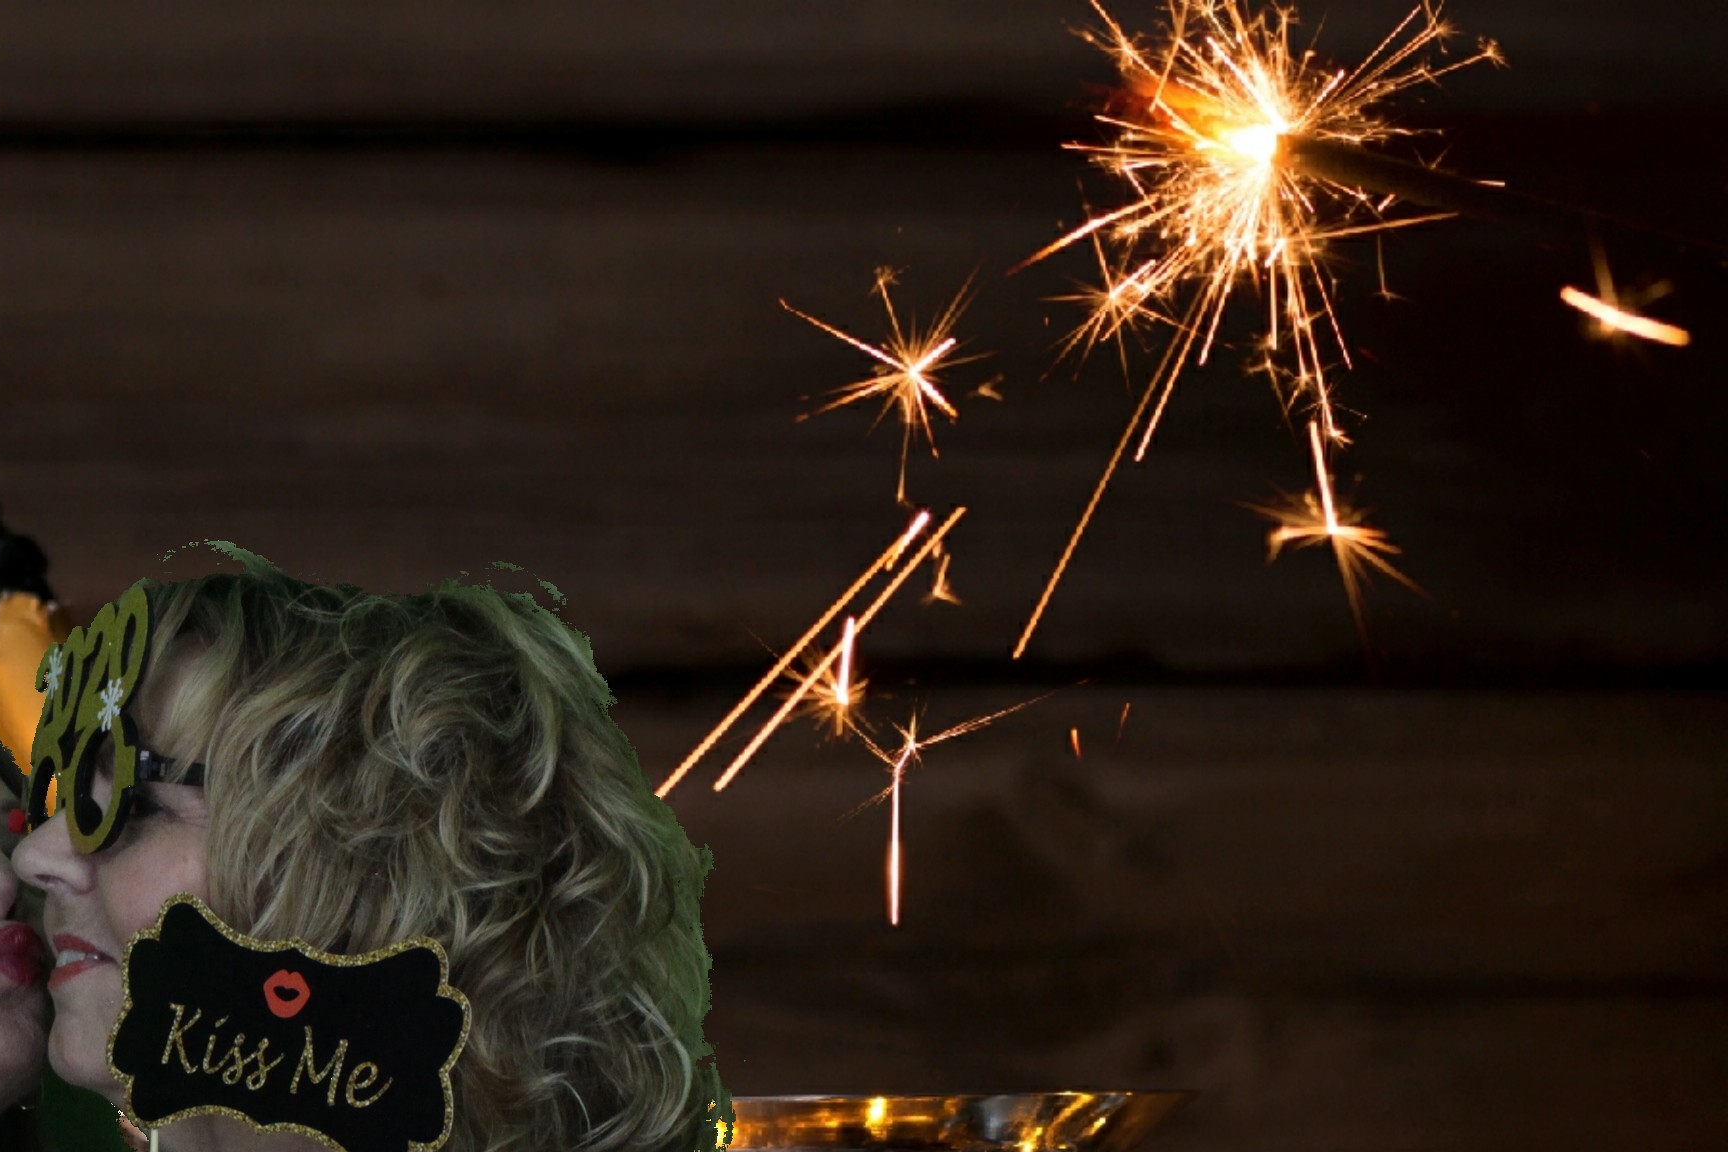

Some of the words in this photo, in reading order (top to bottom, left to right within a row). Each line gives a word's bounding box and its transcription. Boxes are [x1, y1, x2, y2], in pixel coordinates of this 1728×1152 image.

[33, 586, 148, 742] 2020
[161, 1003, 284, 1091] Kiss
[290, 1025, 393, 1108] Me
